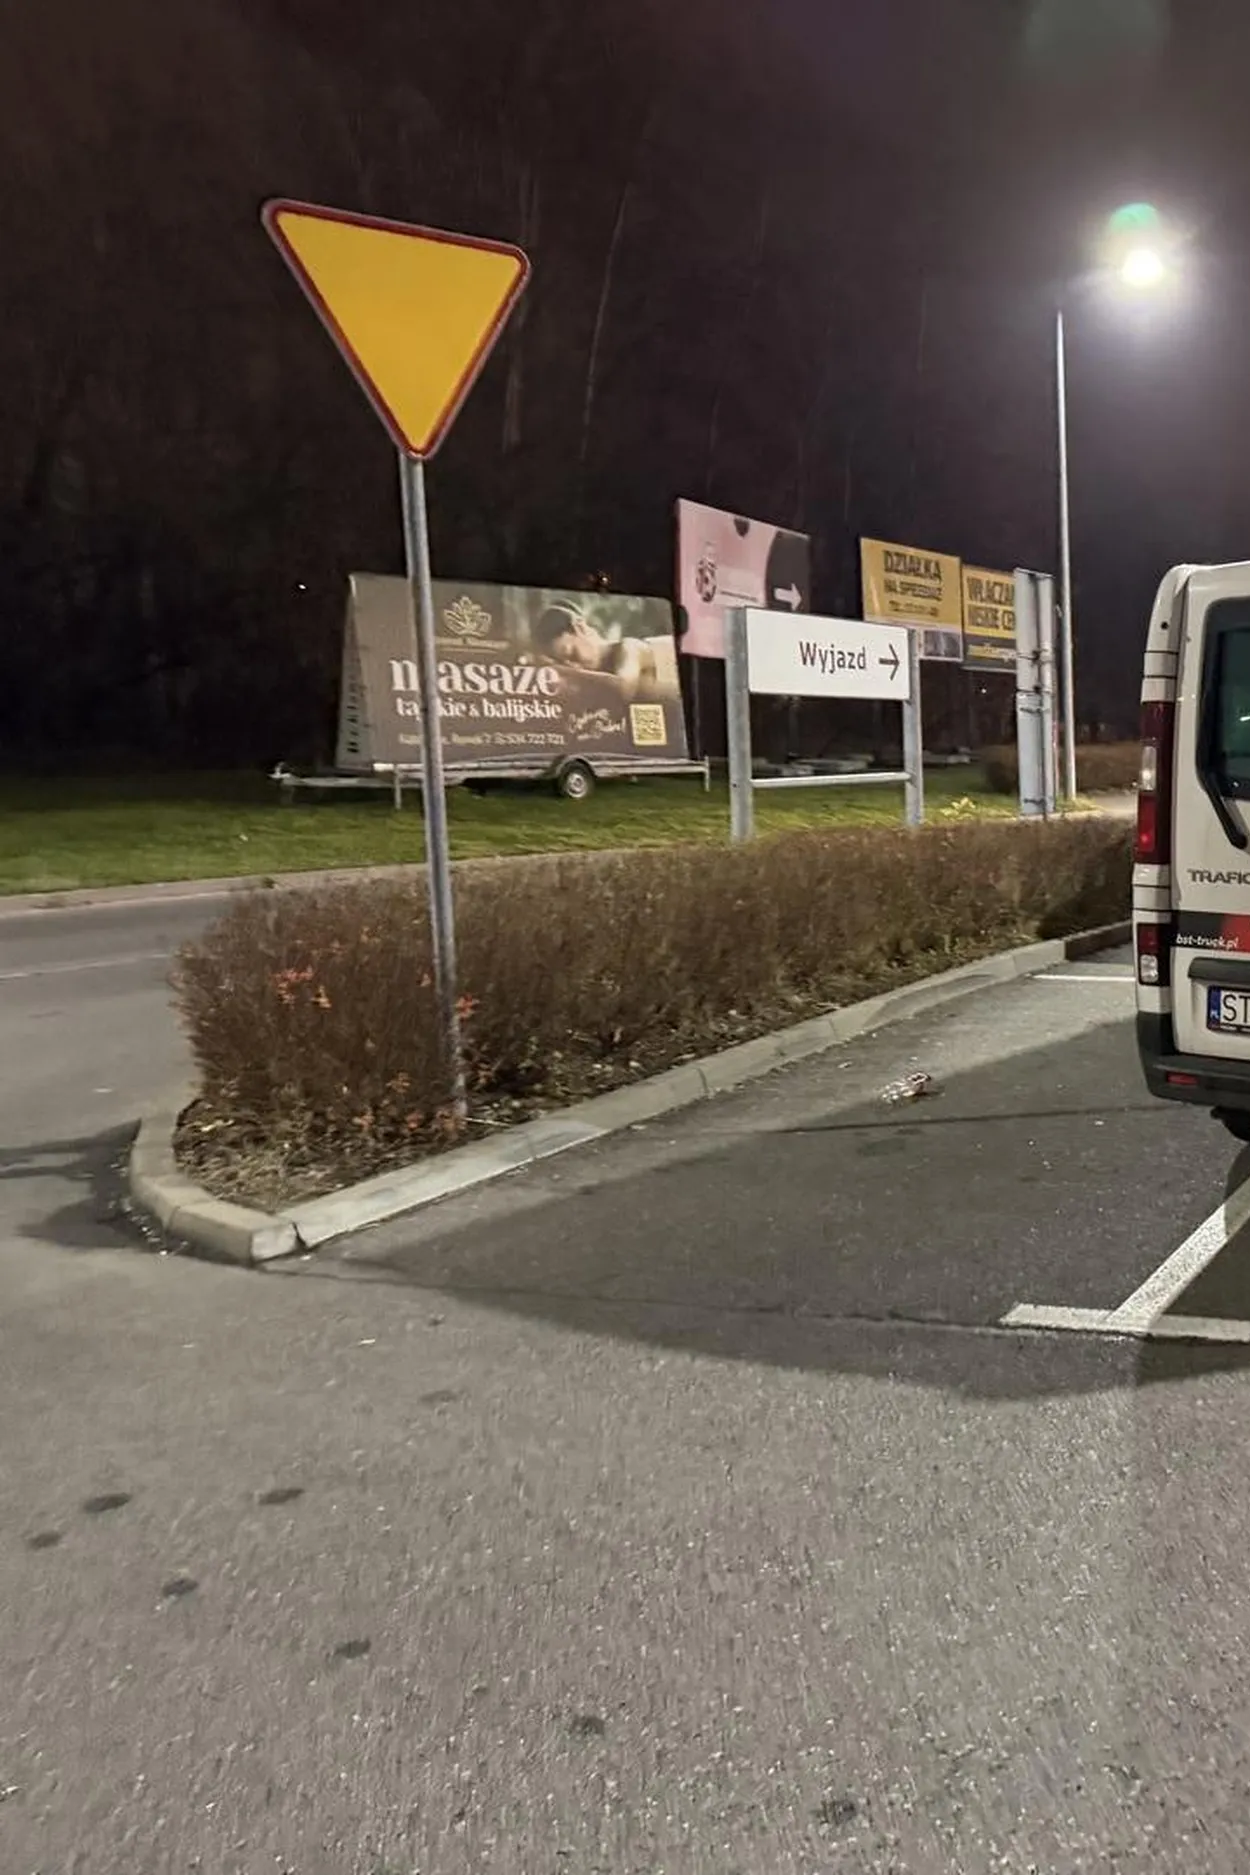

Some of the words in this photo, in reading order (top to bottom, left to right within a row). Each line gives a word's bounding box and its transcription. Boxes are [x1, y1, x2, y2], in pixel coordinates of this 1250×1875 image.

[799, 641, 866, 674] Wyjazd
[389, 656, 561, 697] masaże
[483, 697, 562, 722] balijskie
[1176, 934, 1239, 949] bst-truck.pl
